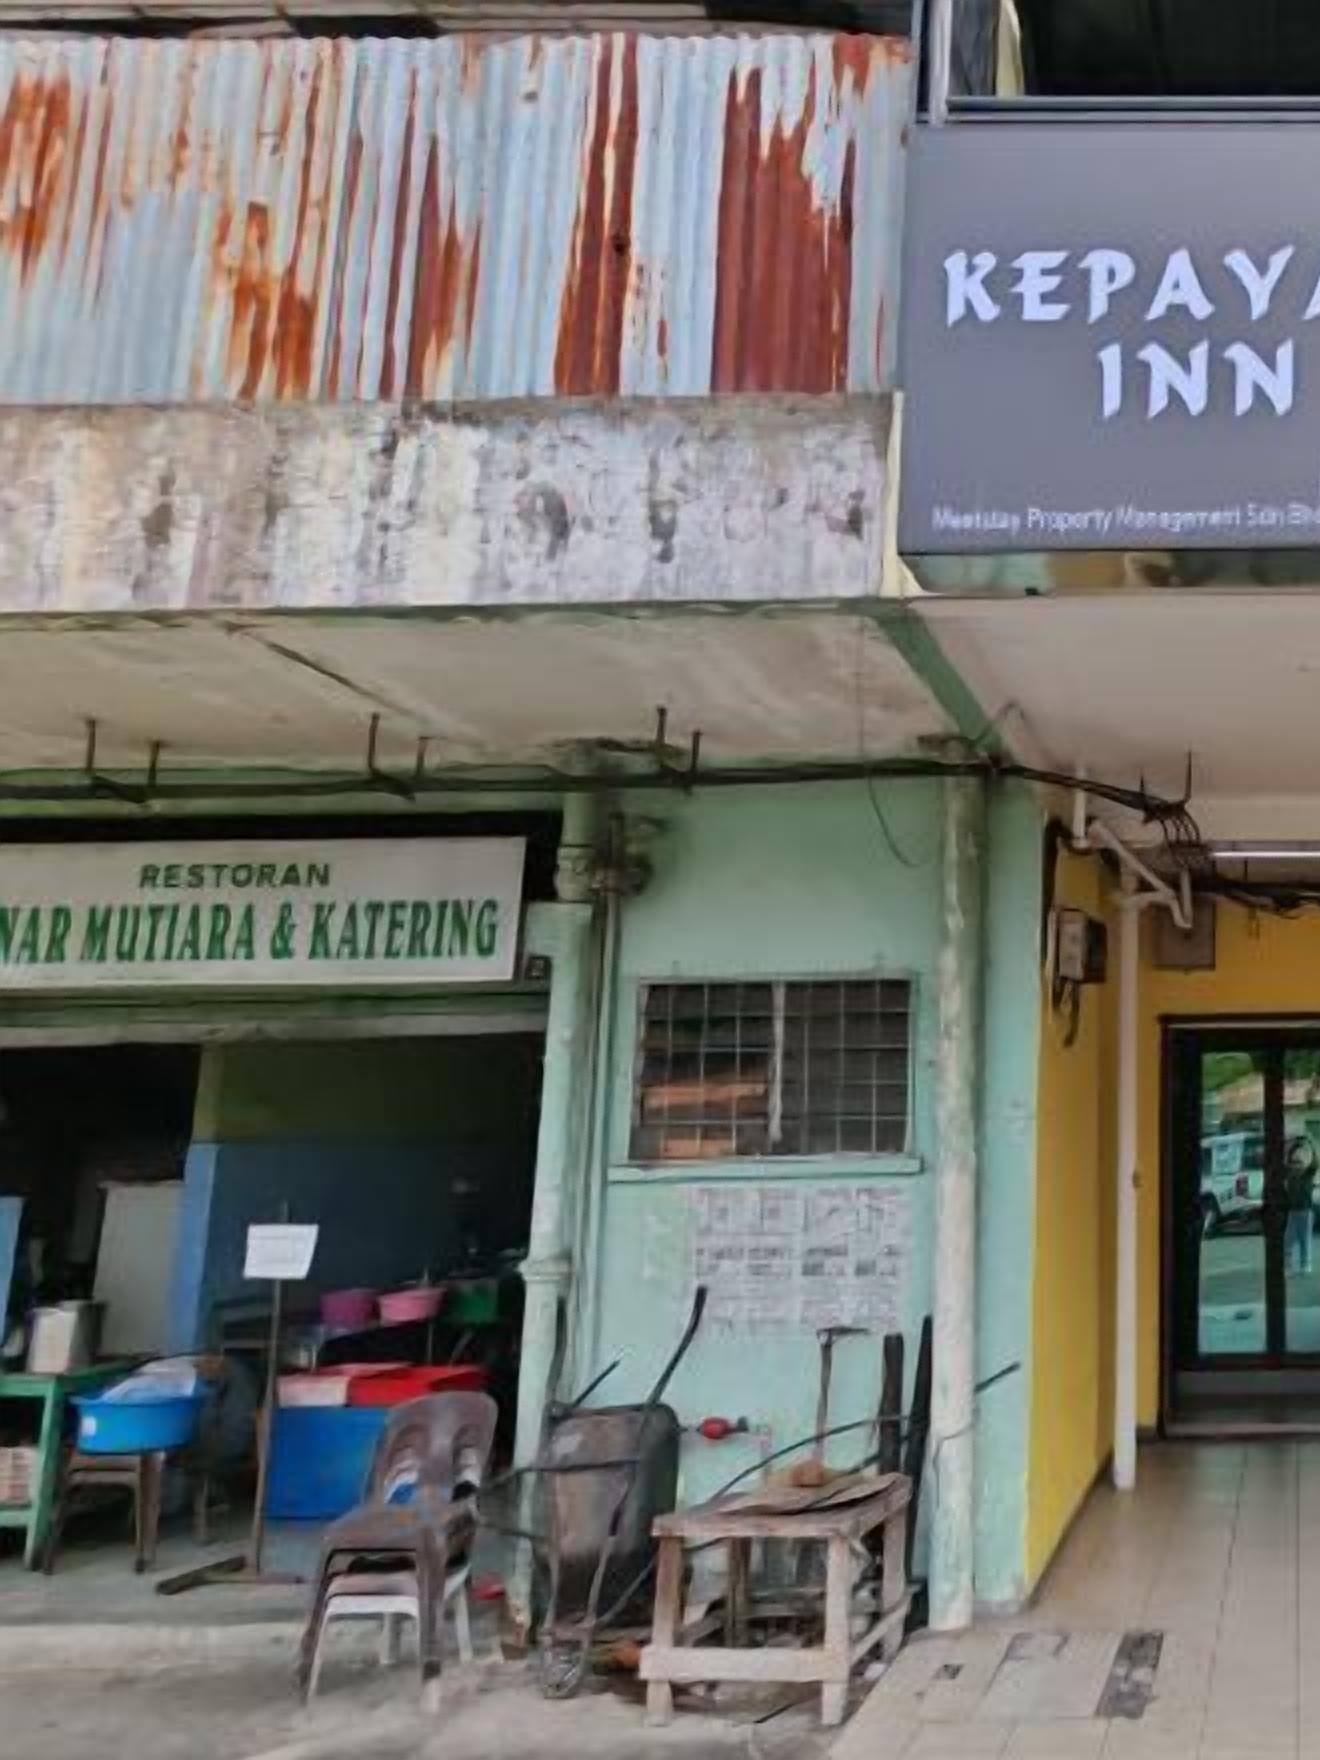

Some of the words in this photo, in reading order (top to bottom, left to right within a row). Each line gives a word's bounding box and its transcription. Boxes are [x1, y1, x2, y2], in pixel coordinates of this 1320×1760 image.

[1097, 338, 1296, 418] INN
[139, 863, 331, 889] RESTORAN
[80, 903, 256, 962] MUTIARA
[269, 903, 296, 960] &
[308, 898, 498, 959] KATERING
